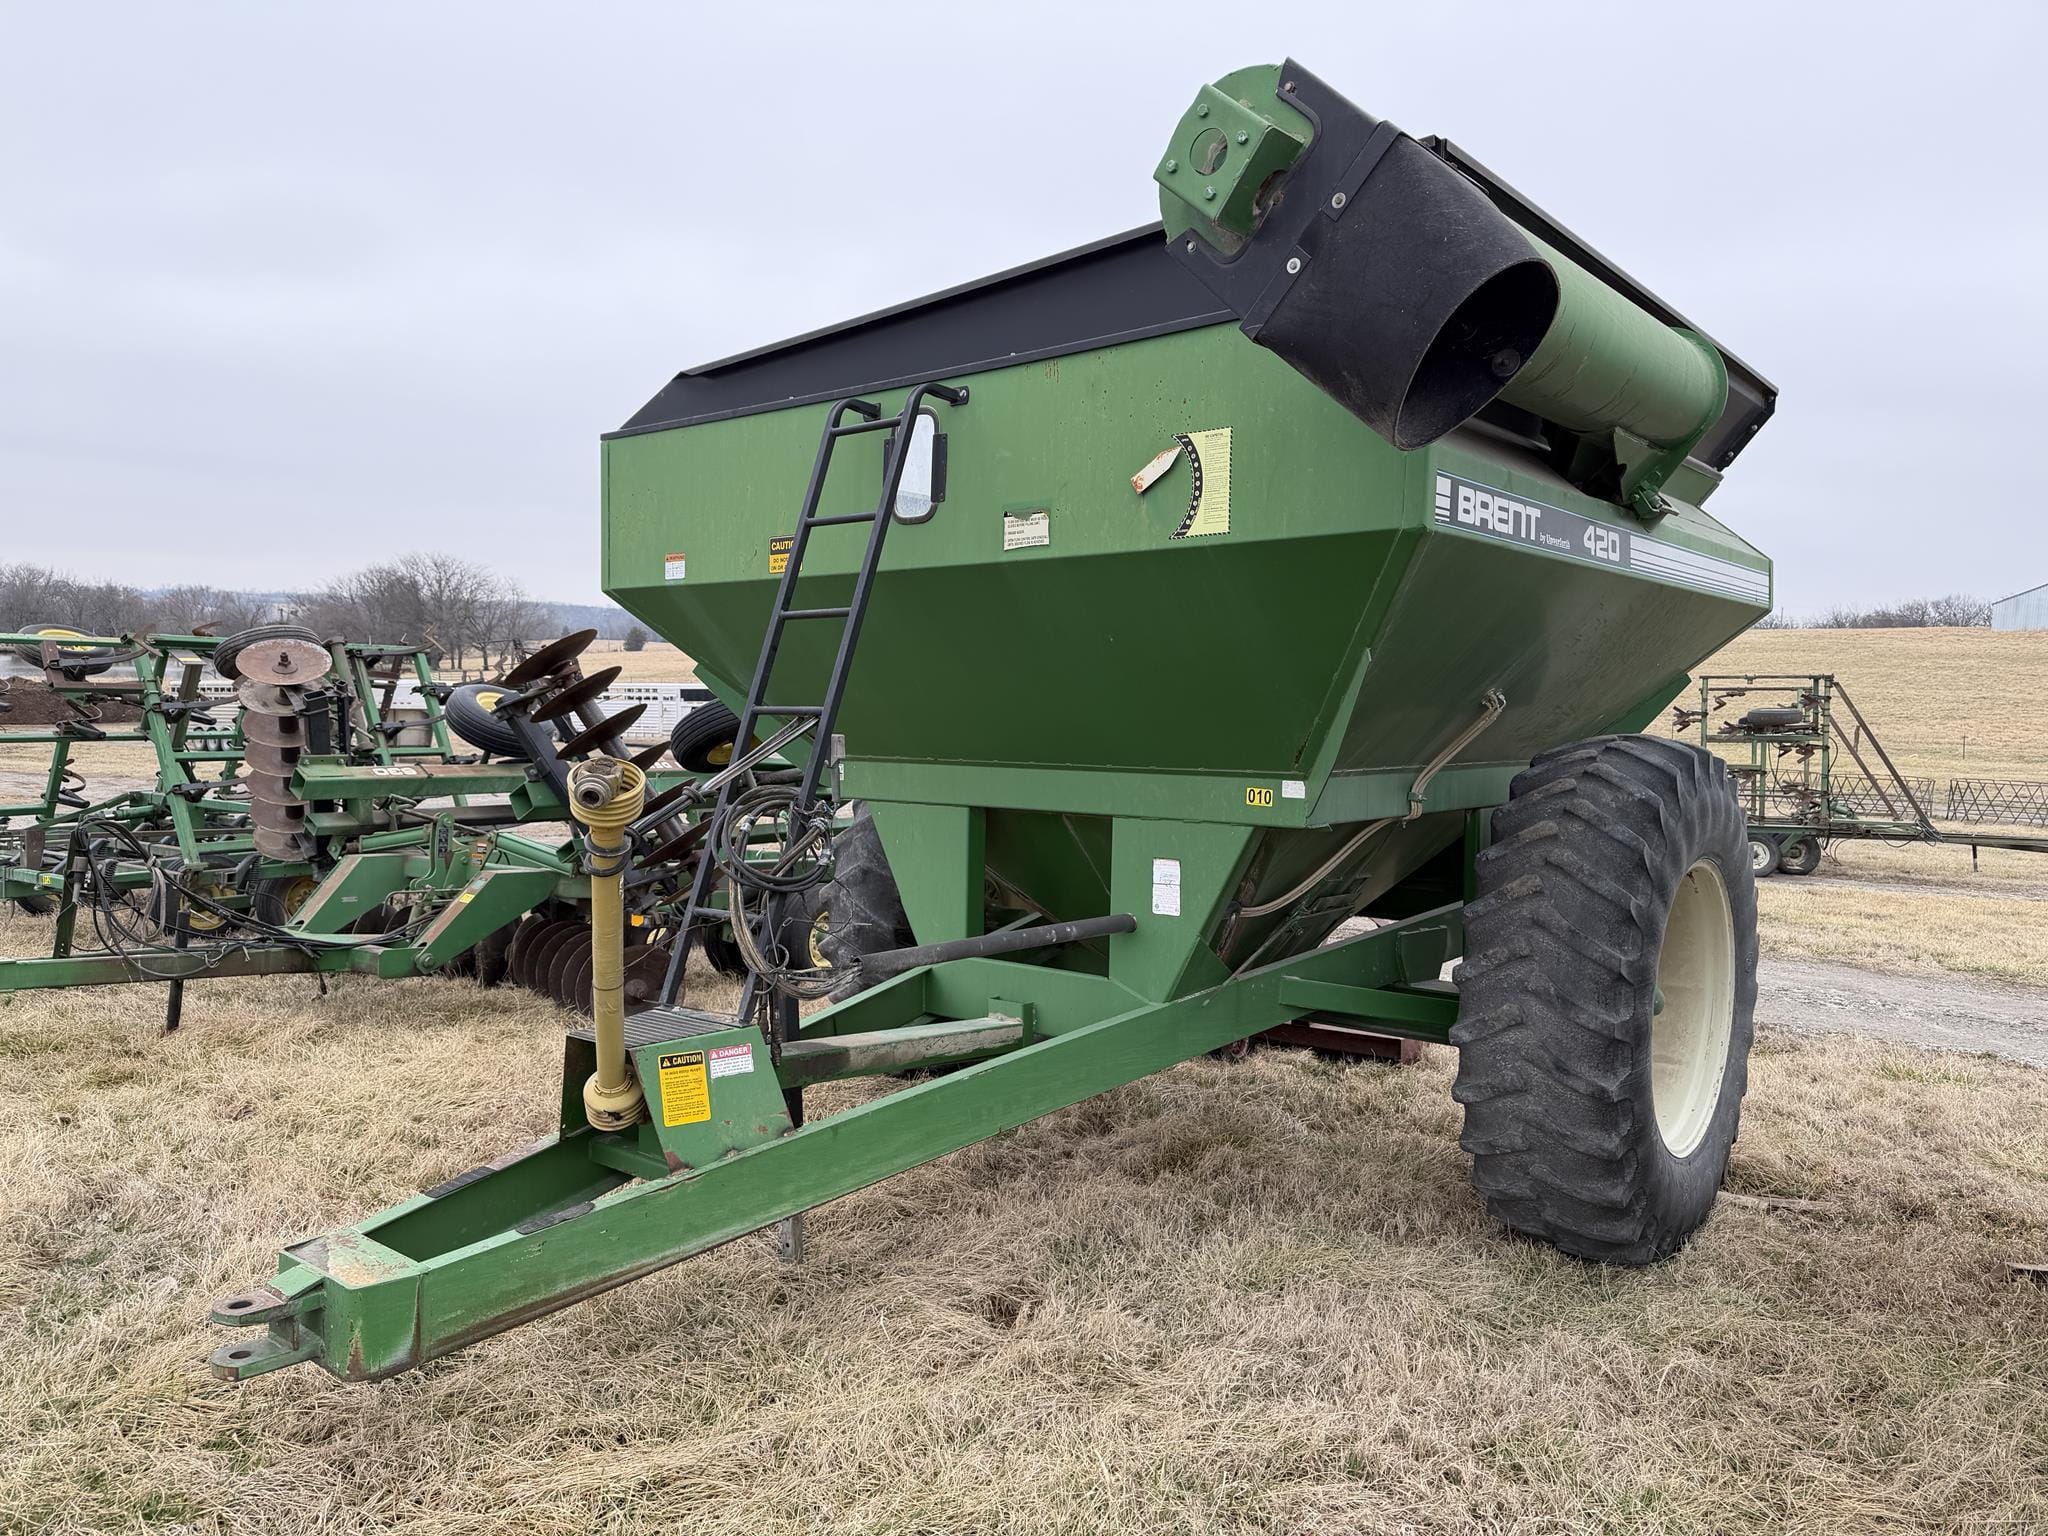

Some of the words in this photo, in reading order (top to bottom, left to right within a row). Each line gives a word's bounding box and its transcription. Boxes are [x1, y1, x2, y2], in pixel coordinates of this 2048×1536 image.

[1457, 485, 1541, 540] BRENT
[771, 540, 794, 551] CAUTI
[1583, 525, 1620, 562] 420
[1247, 788, 1272, 805] 010
[718, 1046, 748, 1057] DANGER
[672, 1053, 702, 1065] CAUTION
